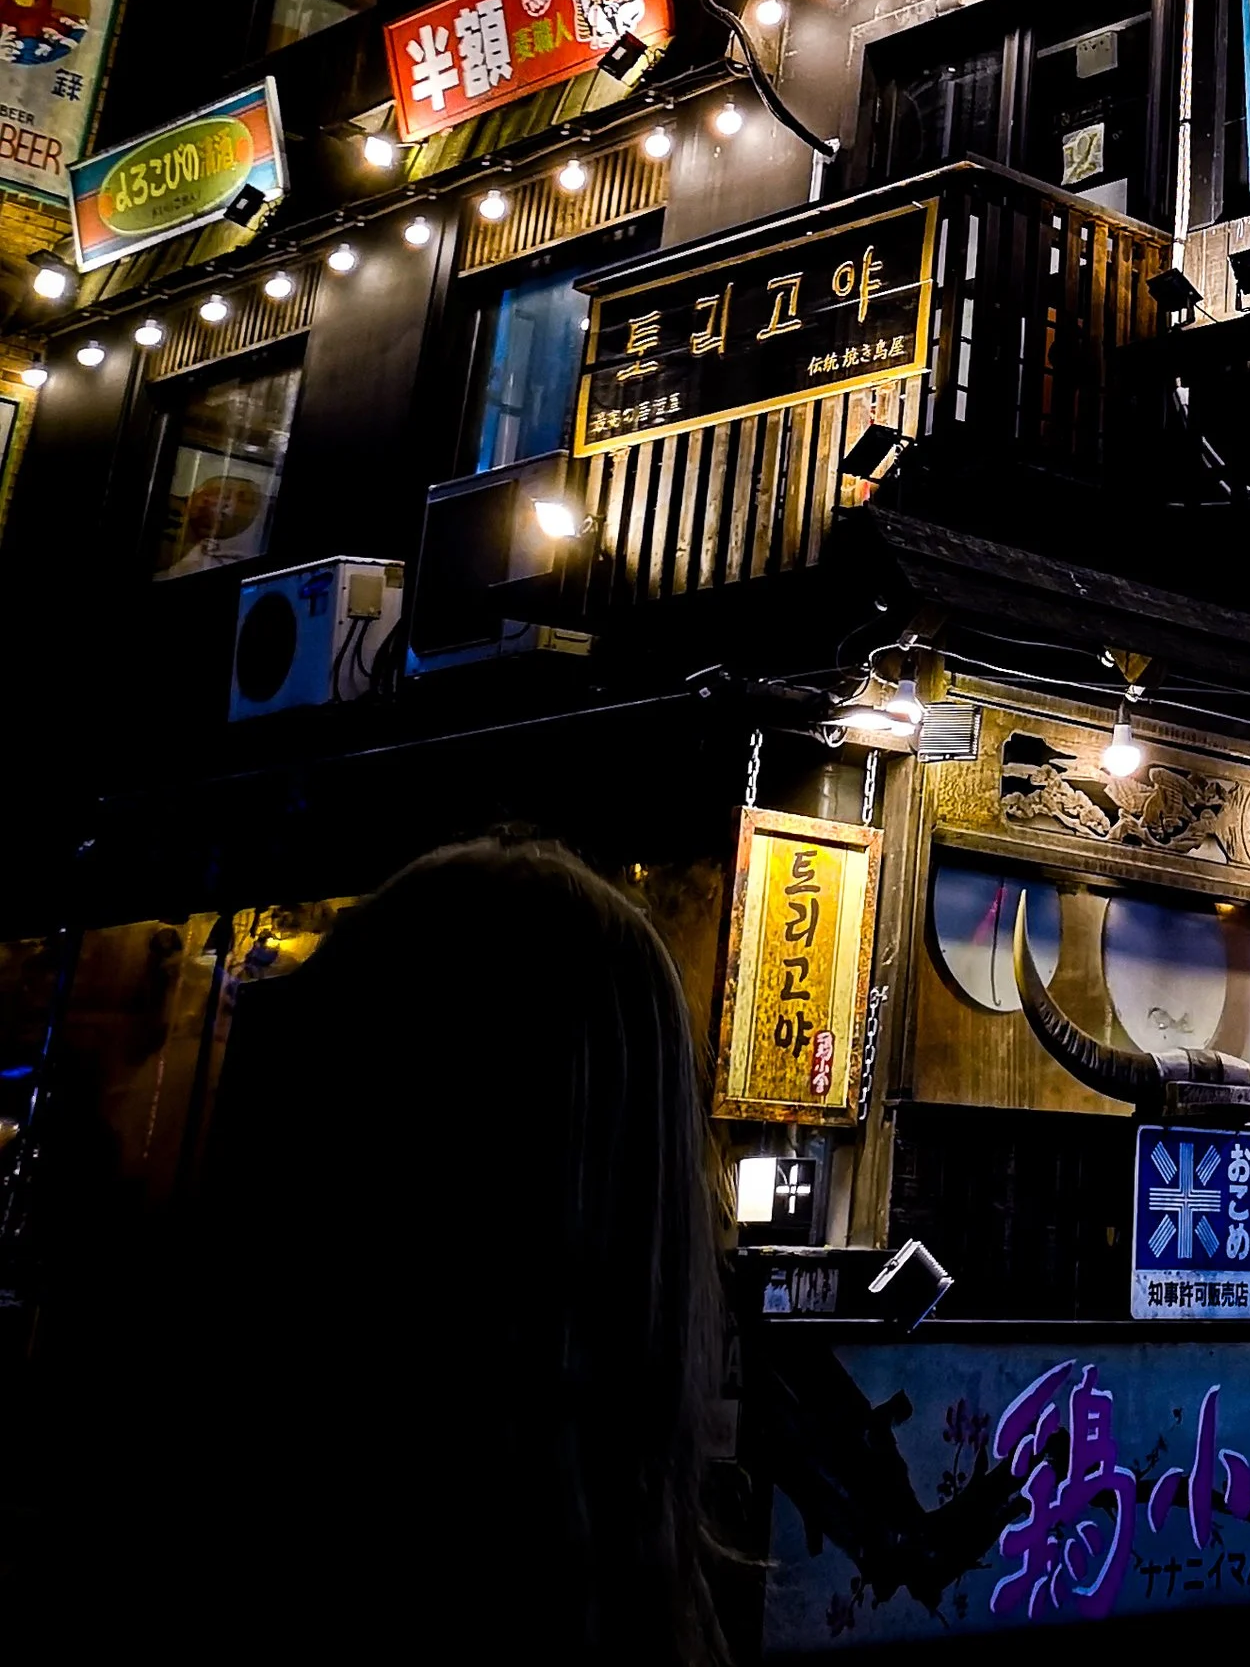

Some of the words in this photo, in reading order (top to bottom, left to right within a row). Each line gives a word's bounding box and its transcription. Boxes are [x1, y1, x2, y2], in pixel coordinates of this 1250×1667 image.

[617, 245, 884, 381] 토리고야
[774, 850, 820, 1059] 토리고야
[1148, 1281, 1249, 1308] 知事許可販売店
